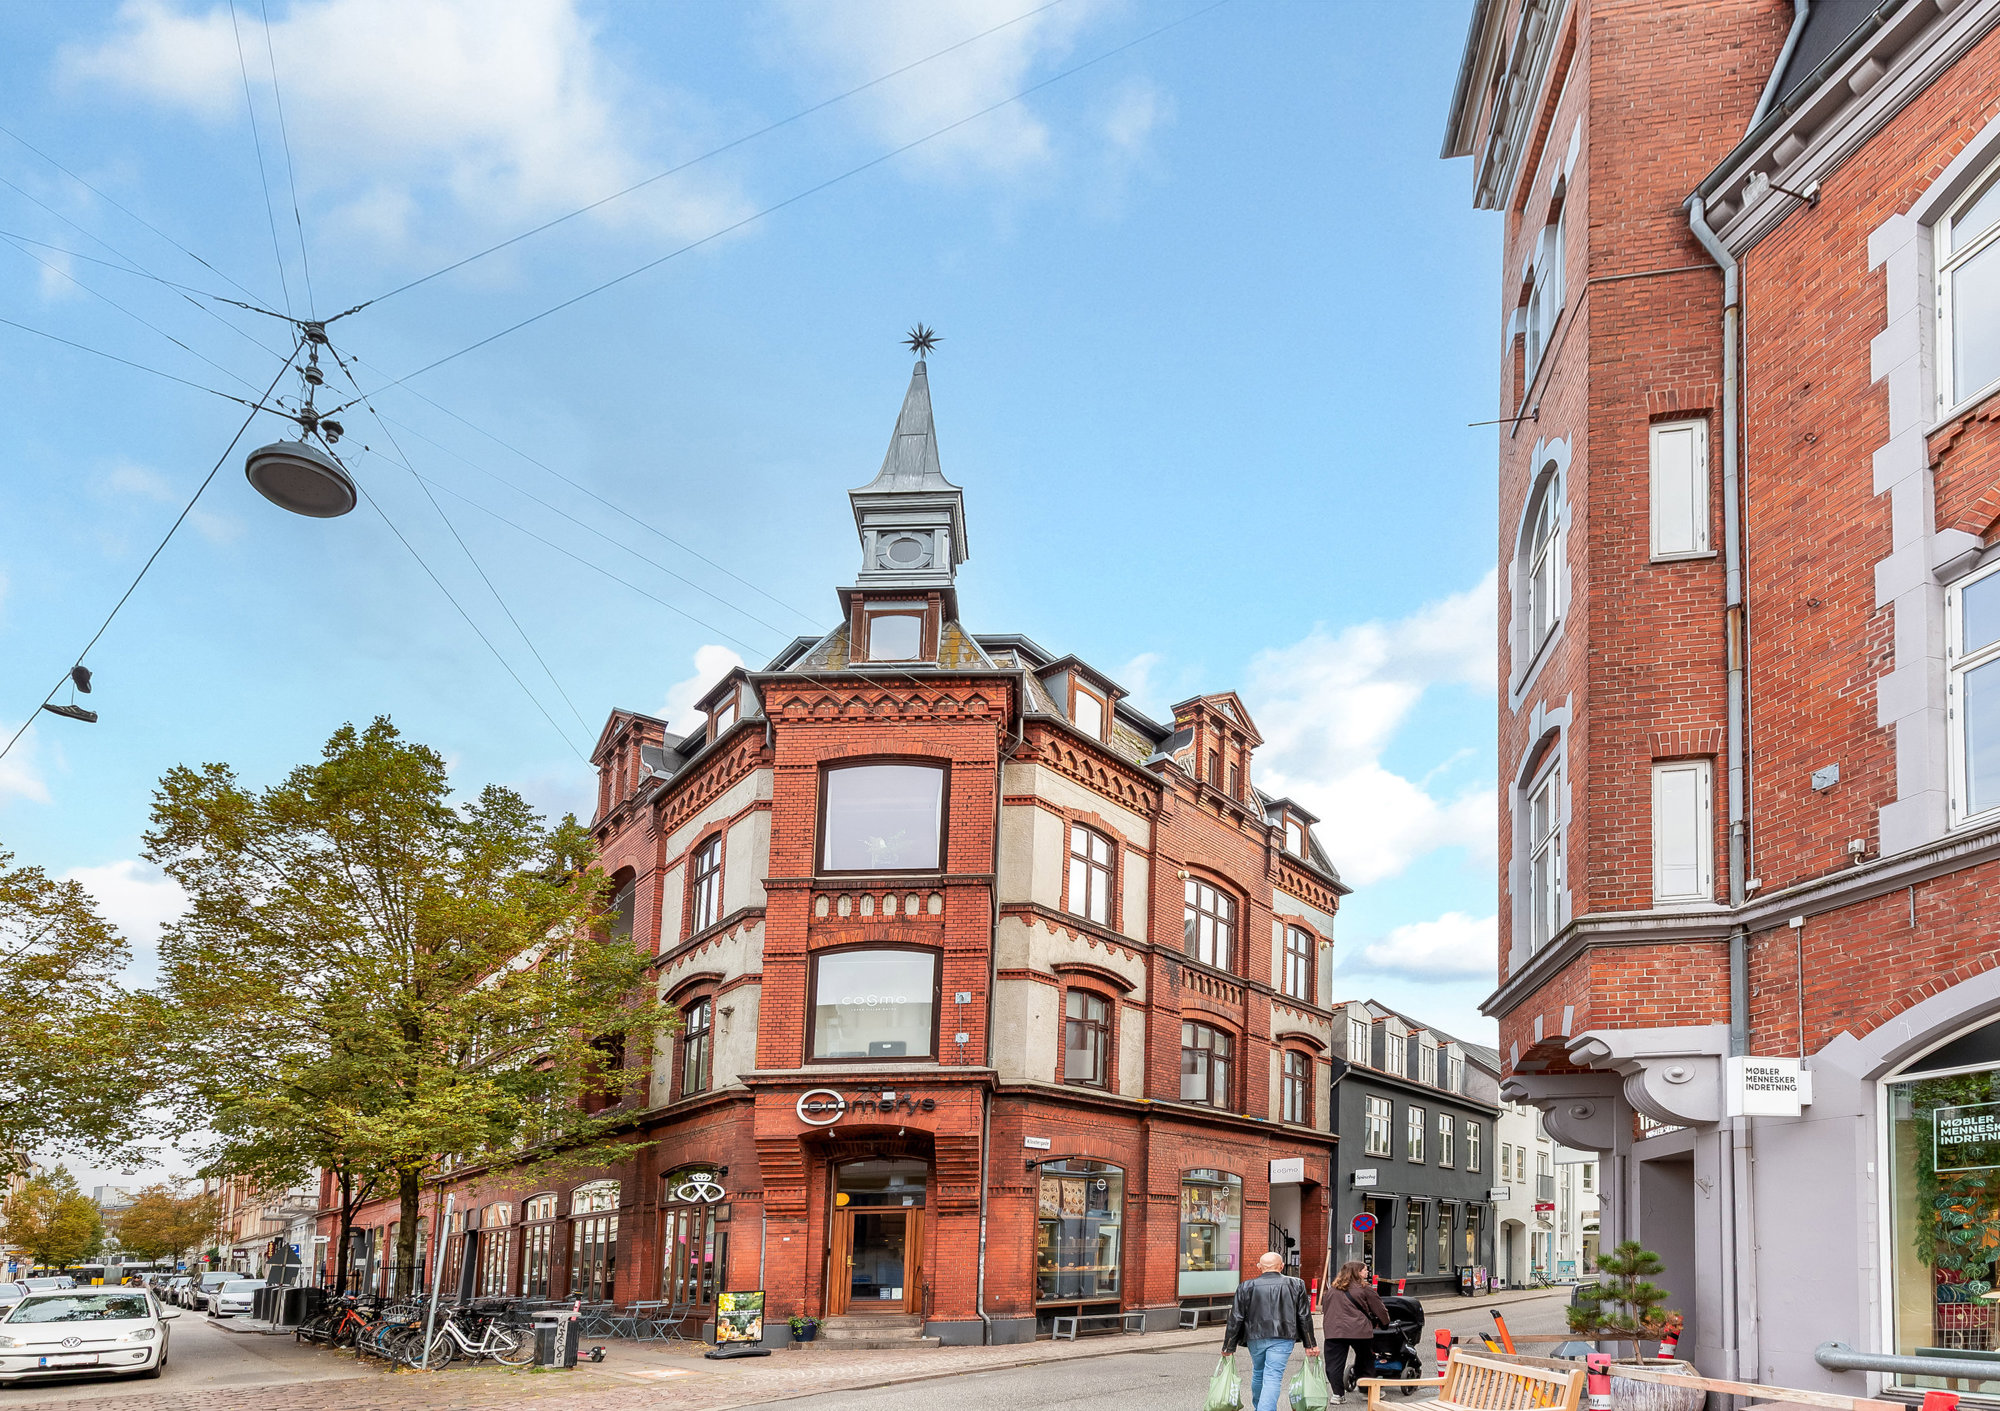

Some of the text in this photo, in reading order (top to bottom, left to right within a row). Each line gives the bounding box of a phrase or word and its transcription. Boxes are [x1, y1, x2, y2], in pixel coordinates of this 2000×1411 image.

[1745, 1067, 1780, 1075] MØBLER
[808, 1098, 936, 1116] emmerys
[1940, 1115, 1995, 1128] MØBLER
